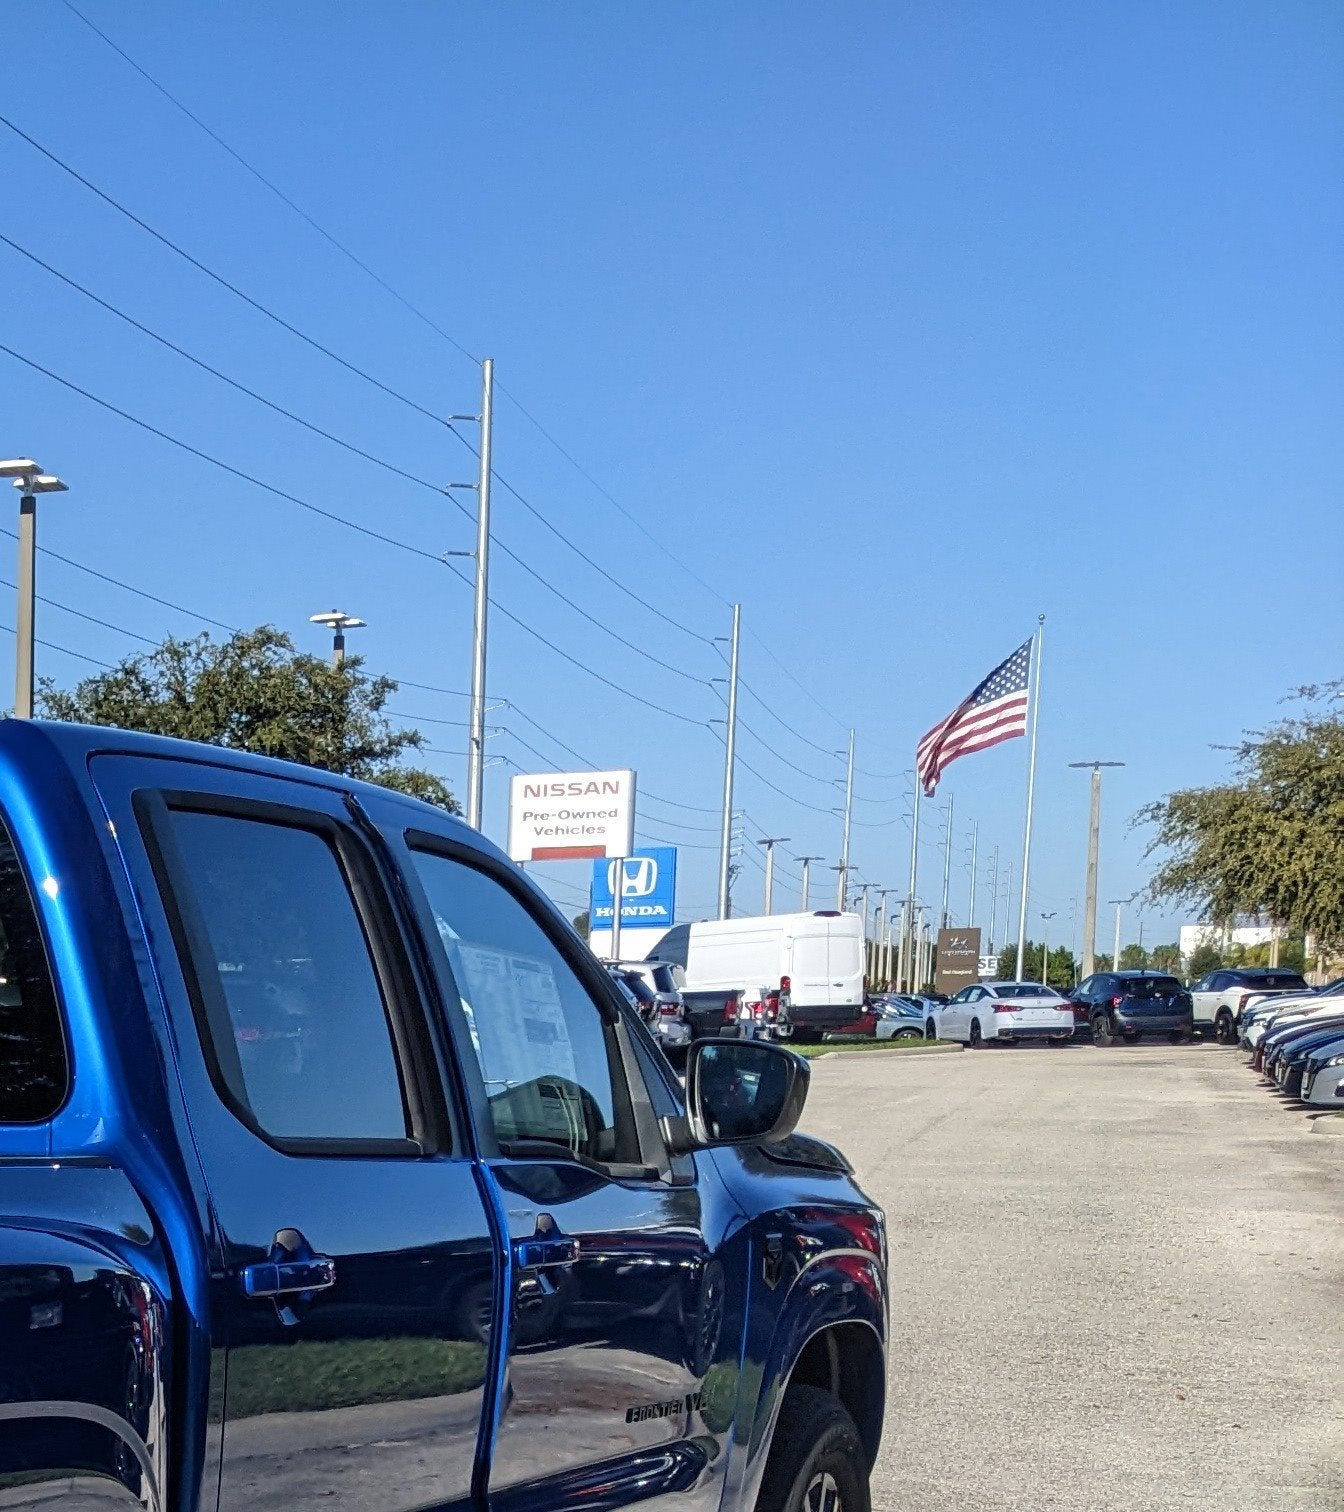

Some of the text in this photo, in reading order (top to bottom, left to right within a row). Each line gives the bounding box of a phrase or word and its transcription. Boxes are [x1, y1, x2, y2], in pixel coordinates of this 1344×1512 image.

[523, 781, 620, 798] NISSAN
[522, 808, 618, 822] Pre-Owned
[534, 825, 606, 836] Vehicles
